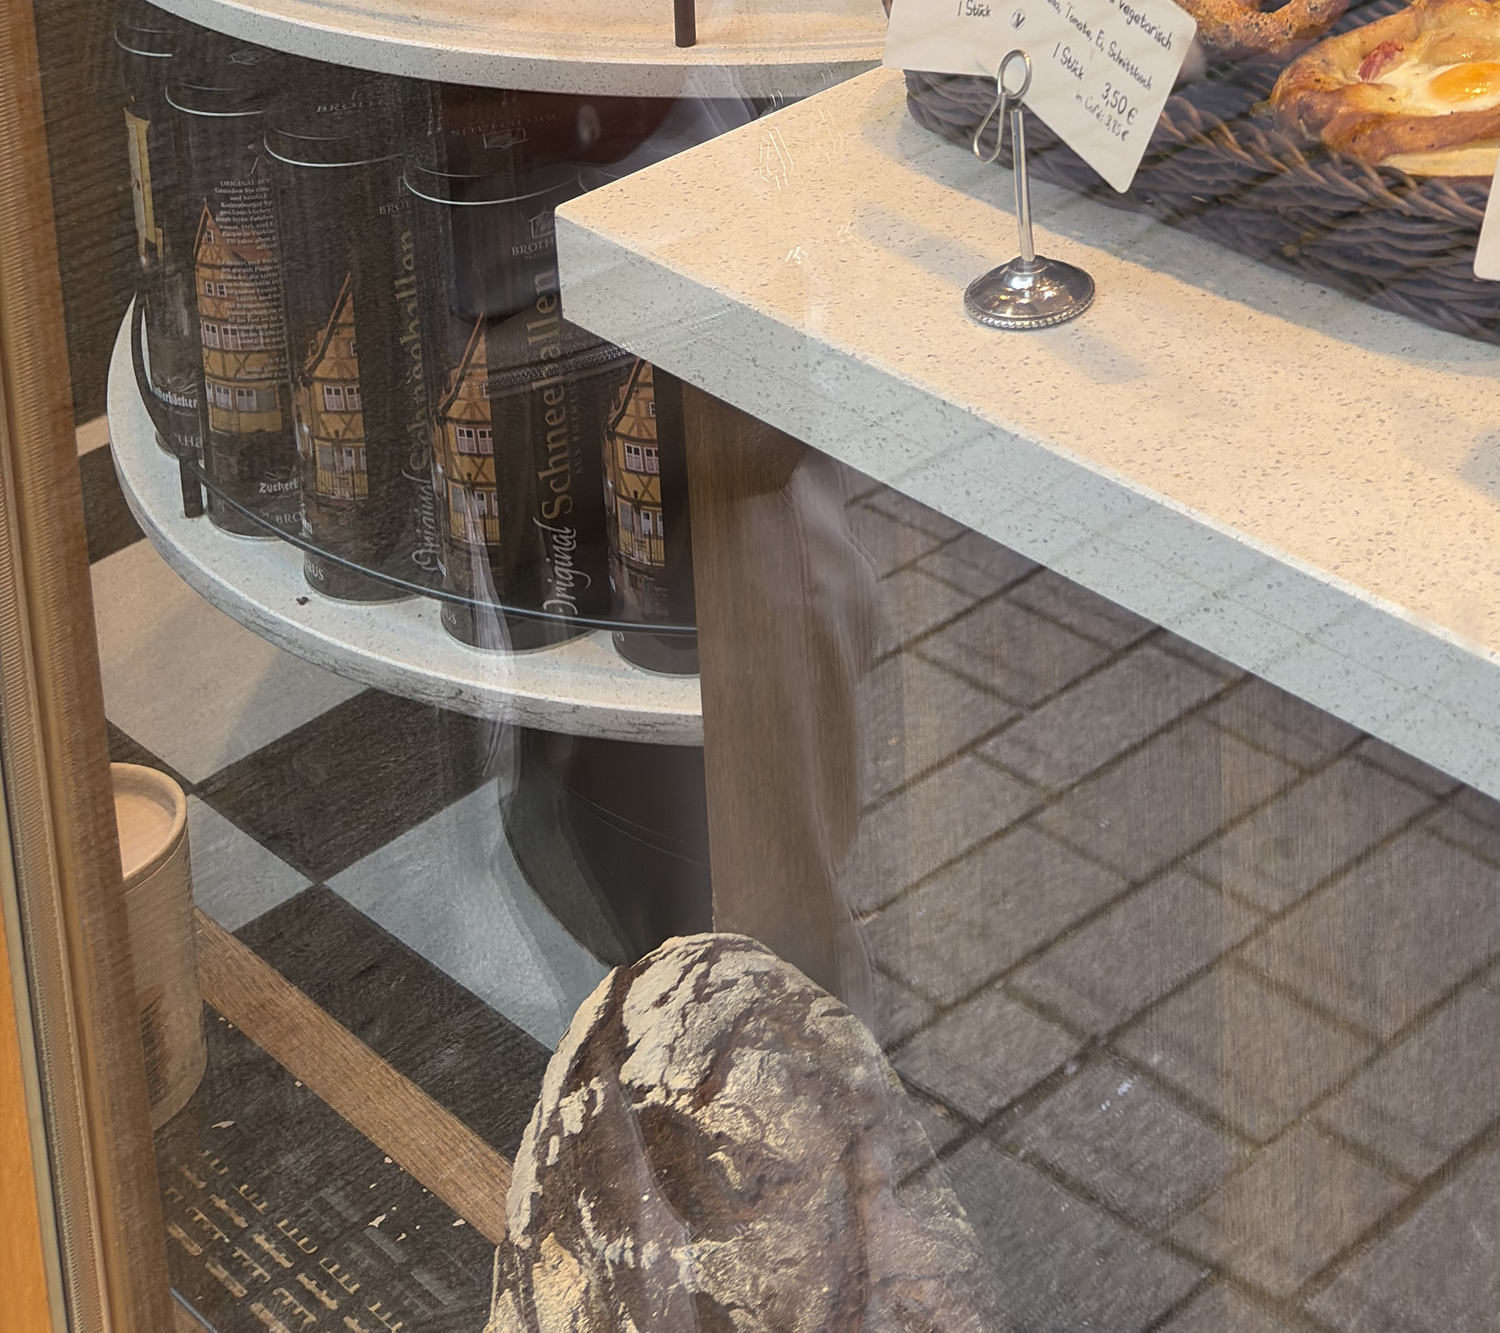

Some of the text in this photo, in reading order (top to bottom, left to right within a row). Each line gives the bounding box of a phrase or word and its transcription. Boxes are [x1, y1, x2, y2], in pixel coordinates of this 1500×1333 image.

[966, 0, 991, 18] Stück
[1060, 46, 1085, 81] Stück
[1101, 82, 1128, 115] 3,50
[512, 237, 555, 257] BROTH
